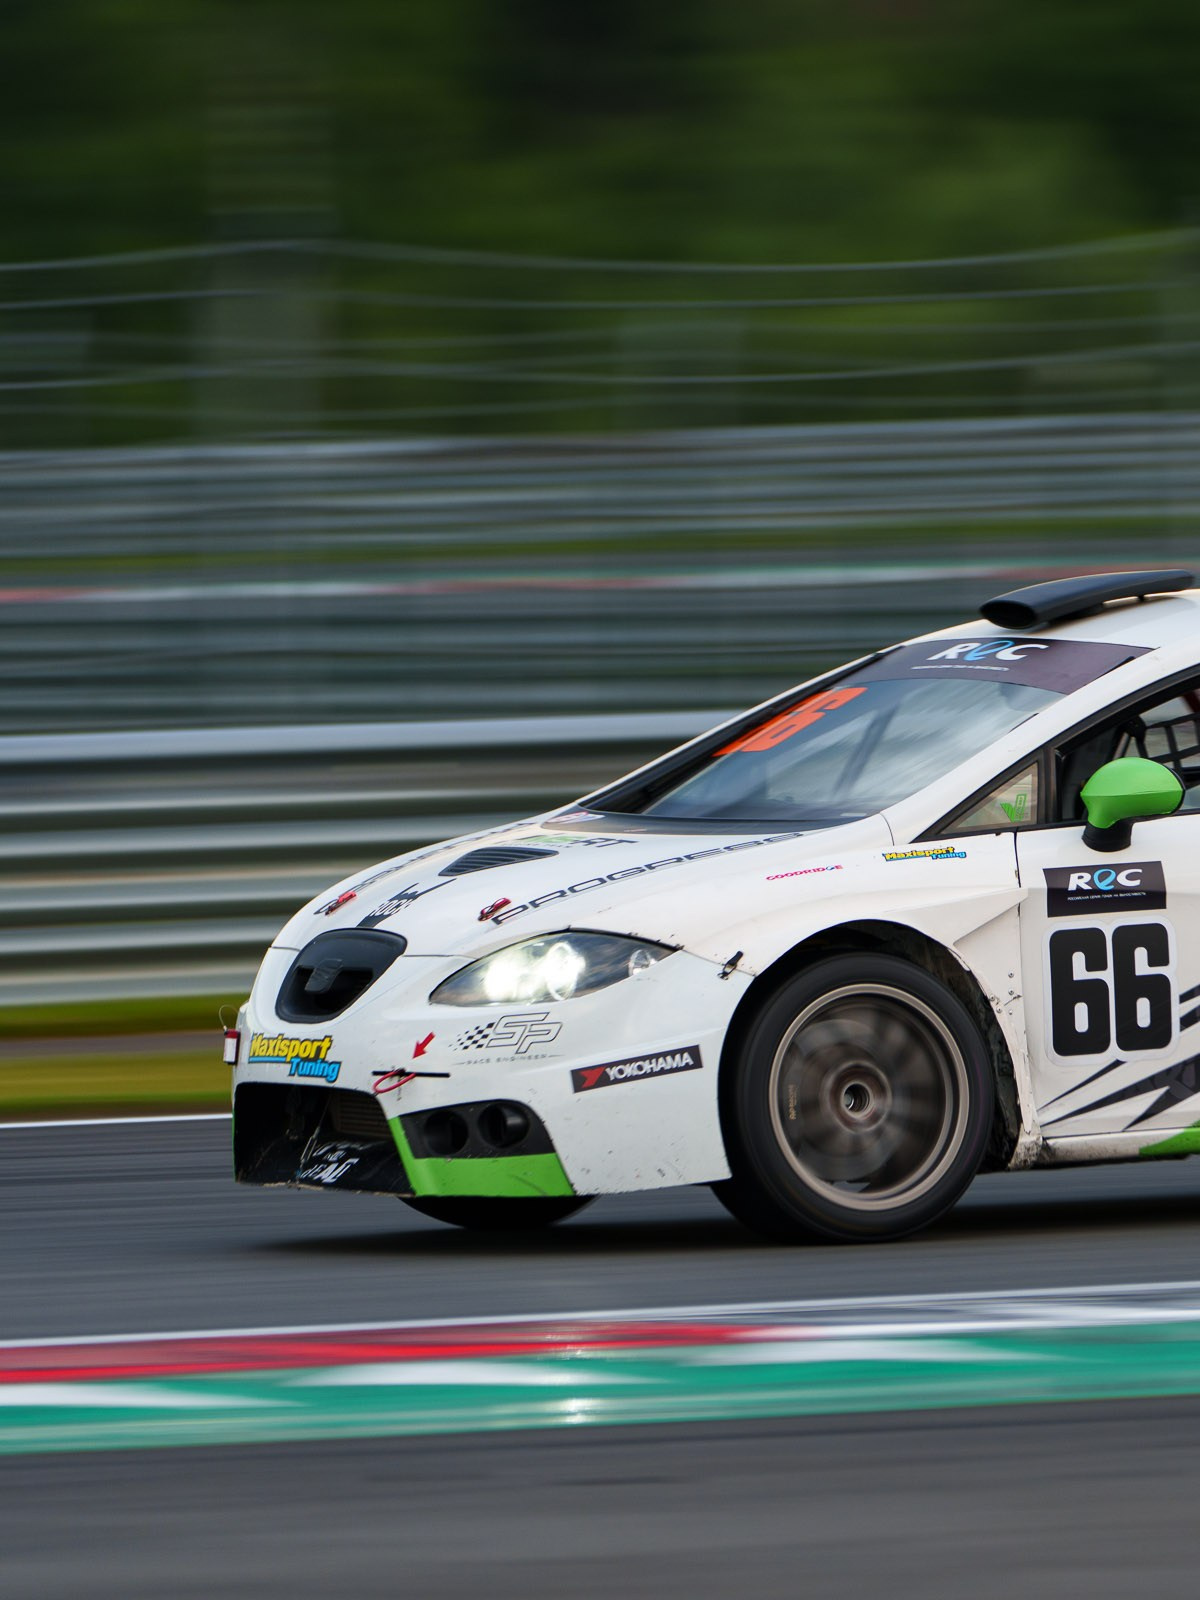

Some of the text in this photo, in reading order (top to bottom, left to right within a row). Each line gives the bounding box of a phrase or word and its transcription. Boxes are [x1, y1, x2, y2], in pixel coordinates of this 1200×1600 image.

[883, 846, 955, 861] Maxisport
[931, 851, 967, 860] Tuning
[491, 832, 804, 926] PROGRESS
[766, 864, 843, 881] GOODRIDGE
[1048, 922, 1173, 1057] 66
[249, 1033, 333, 1062] Maxisport
[289, 1058, 341, 1083] Tuning
[605, 1051, 694, 1081] YOKOHAMA
